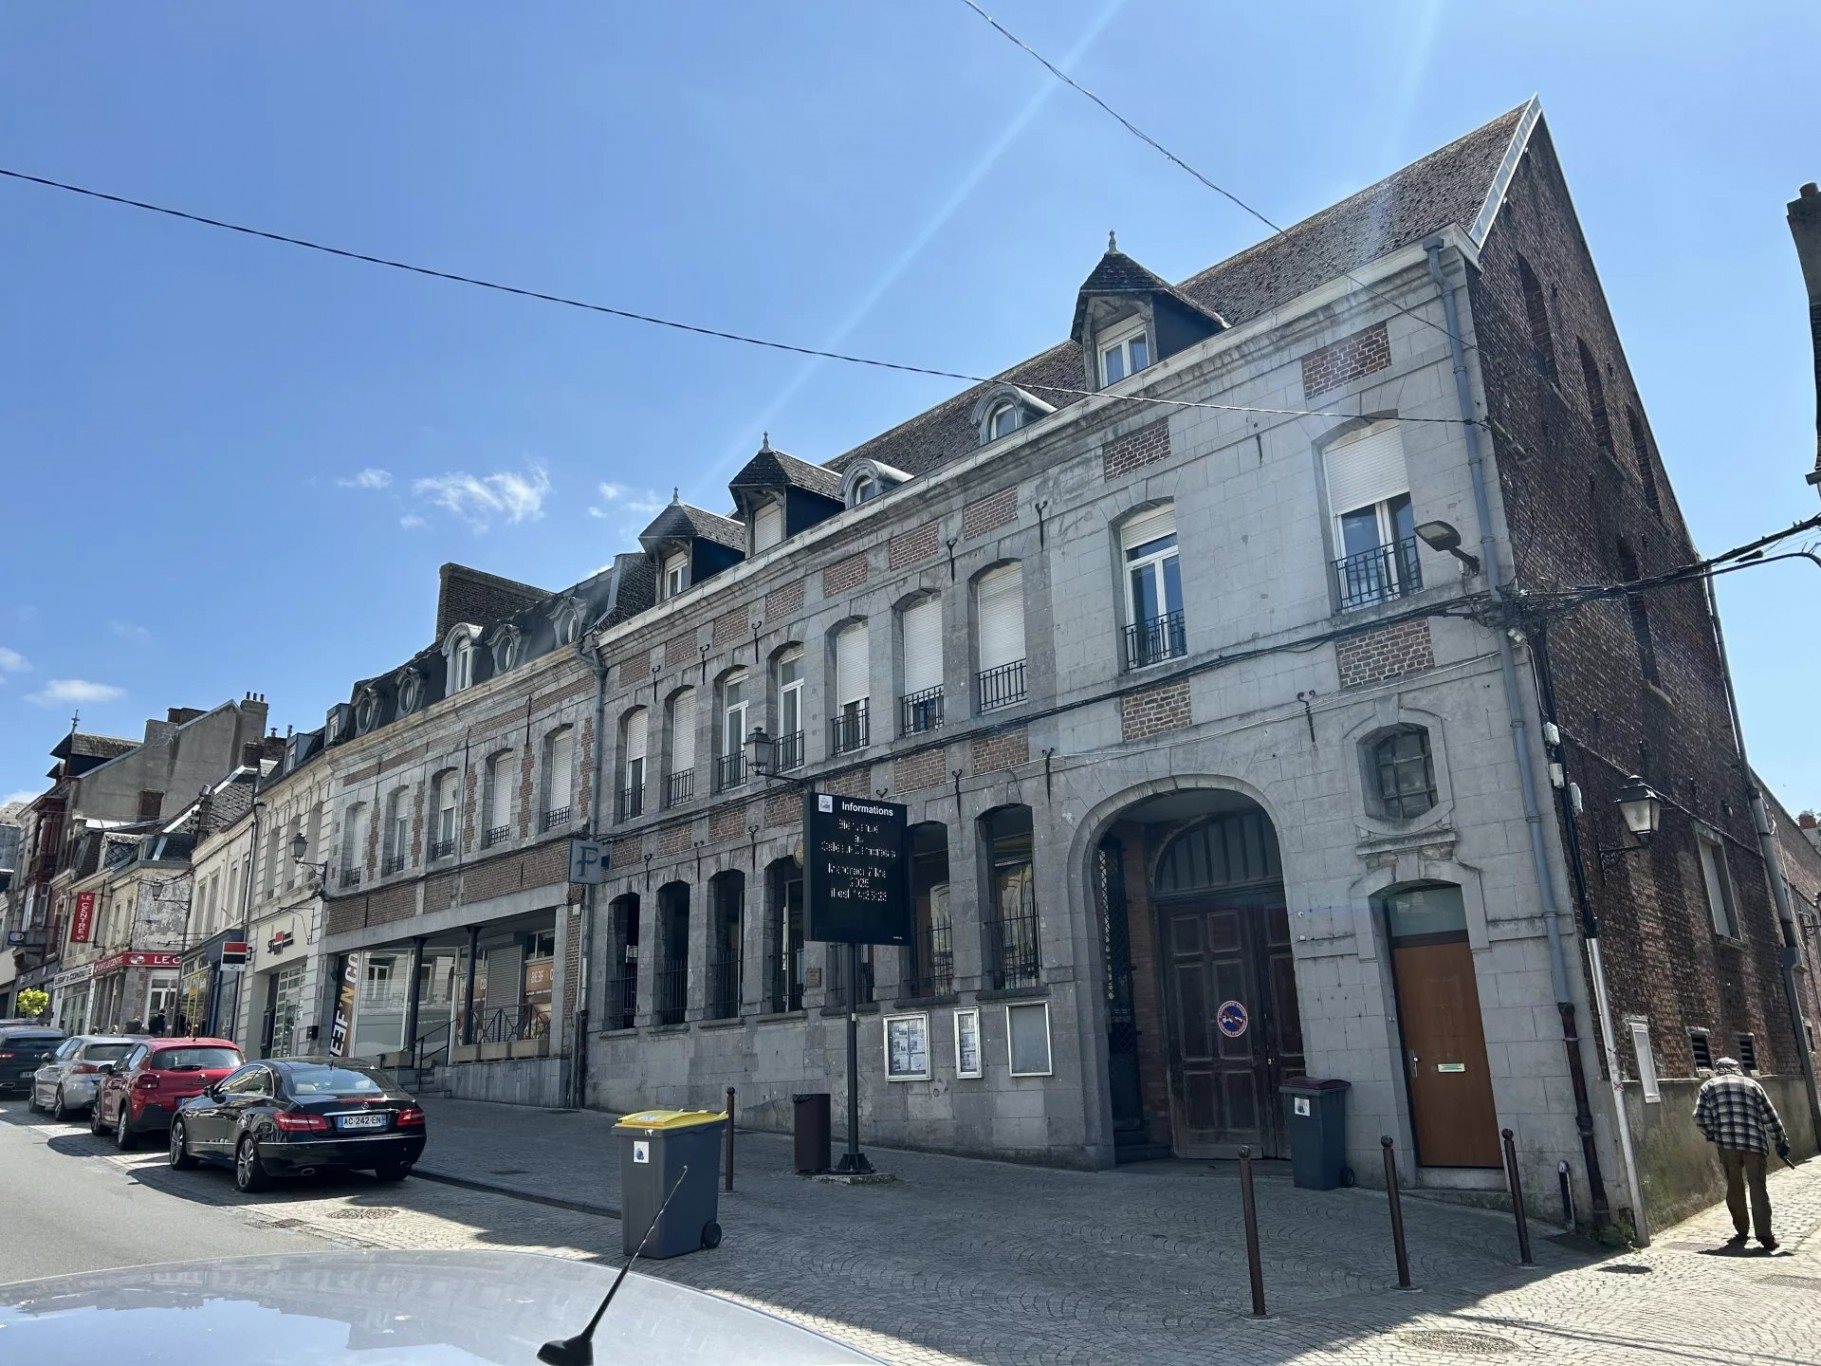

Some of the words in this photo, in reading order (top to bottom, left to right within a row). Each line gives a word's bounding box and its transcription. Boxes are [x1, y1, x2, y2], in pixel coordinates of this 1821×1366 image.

[842, 801, 894, 817] Informations
[154, 955, 170, 964] LE
[330, 1010, 348, 1057] EEF
